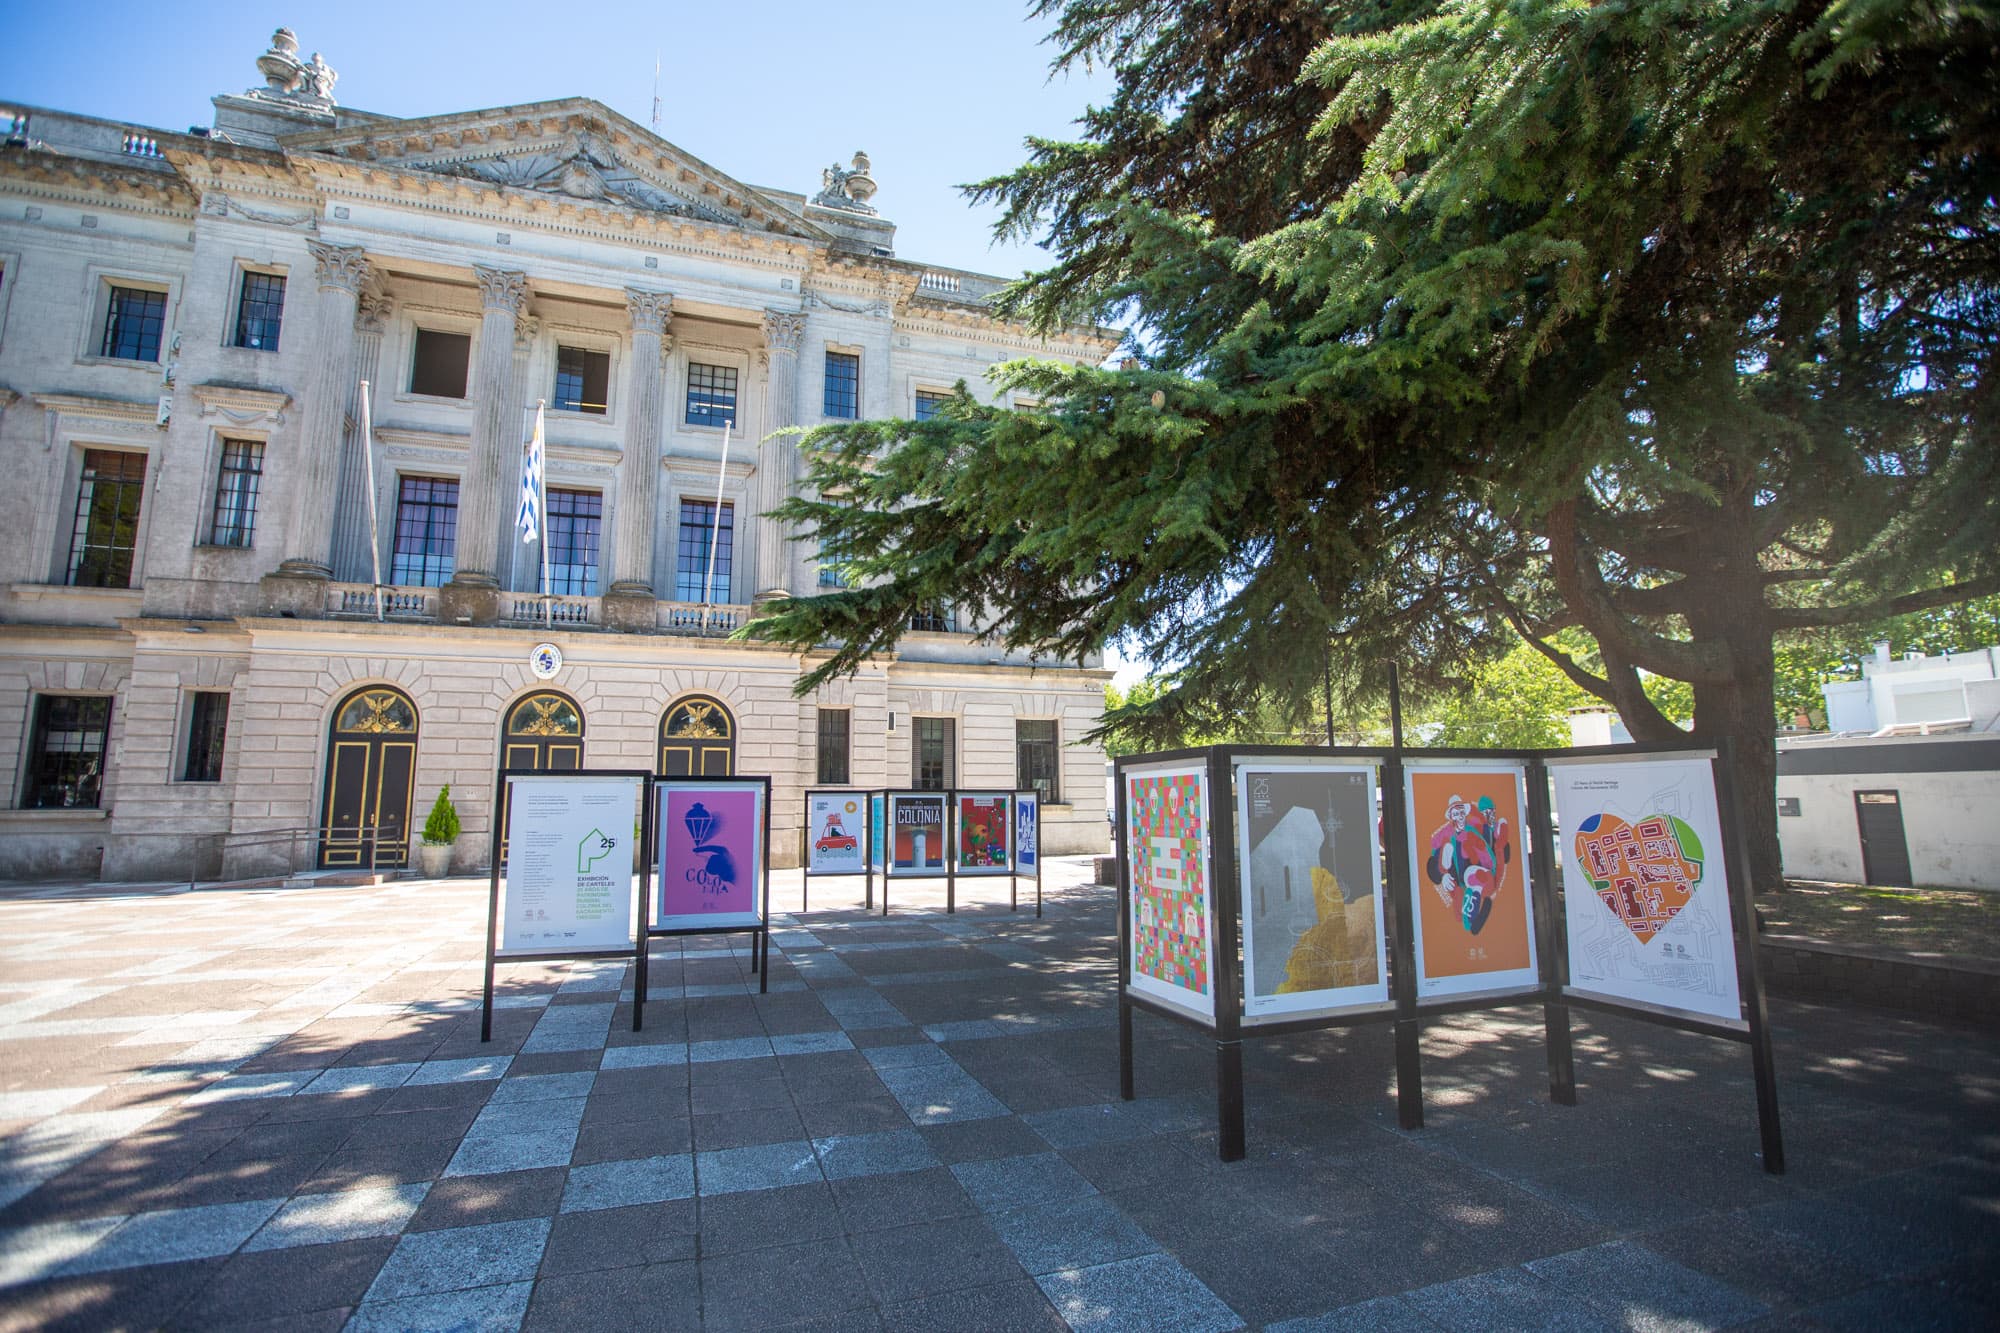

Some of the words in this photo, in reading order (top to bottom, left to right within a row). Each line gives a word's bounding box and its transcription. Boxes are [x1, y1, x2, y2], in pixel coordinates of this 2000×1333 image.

[1253, 778, 1270, 795] 25
[897, 809, 941, 824] COLONIA
[600, 838, 616, 849] 25
[1462, 894, 1477, 917] 25
